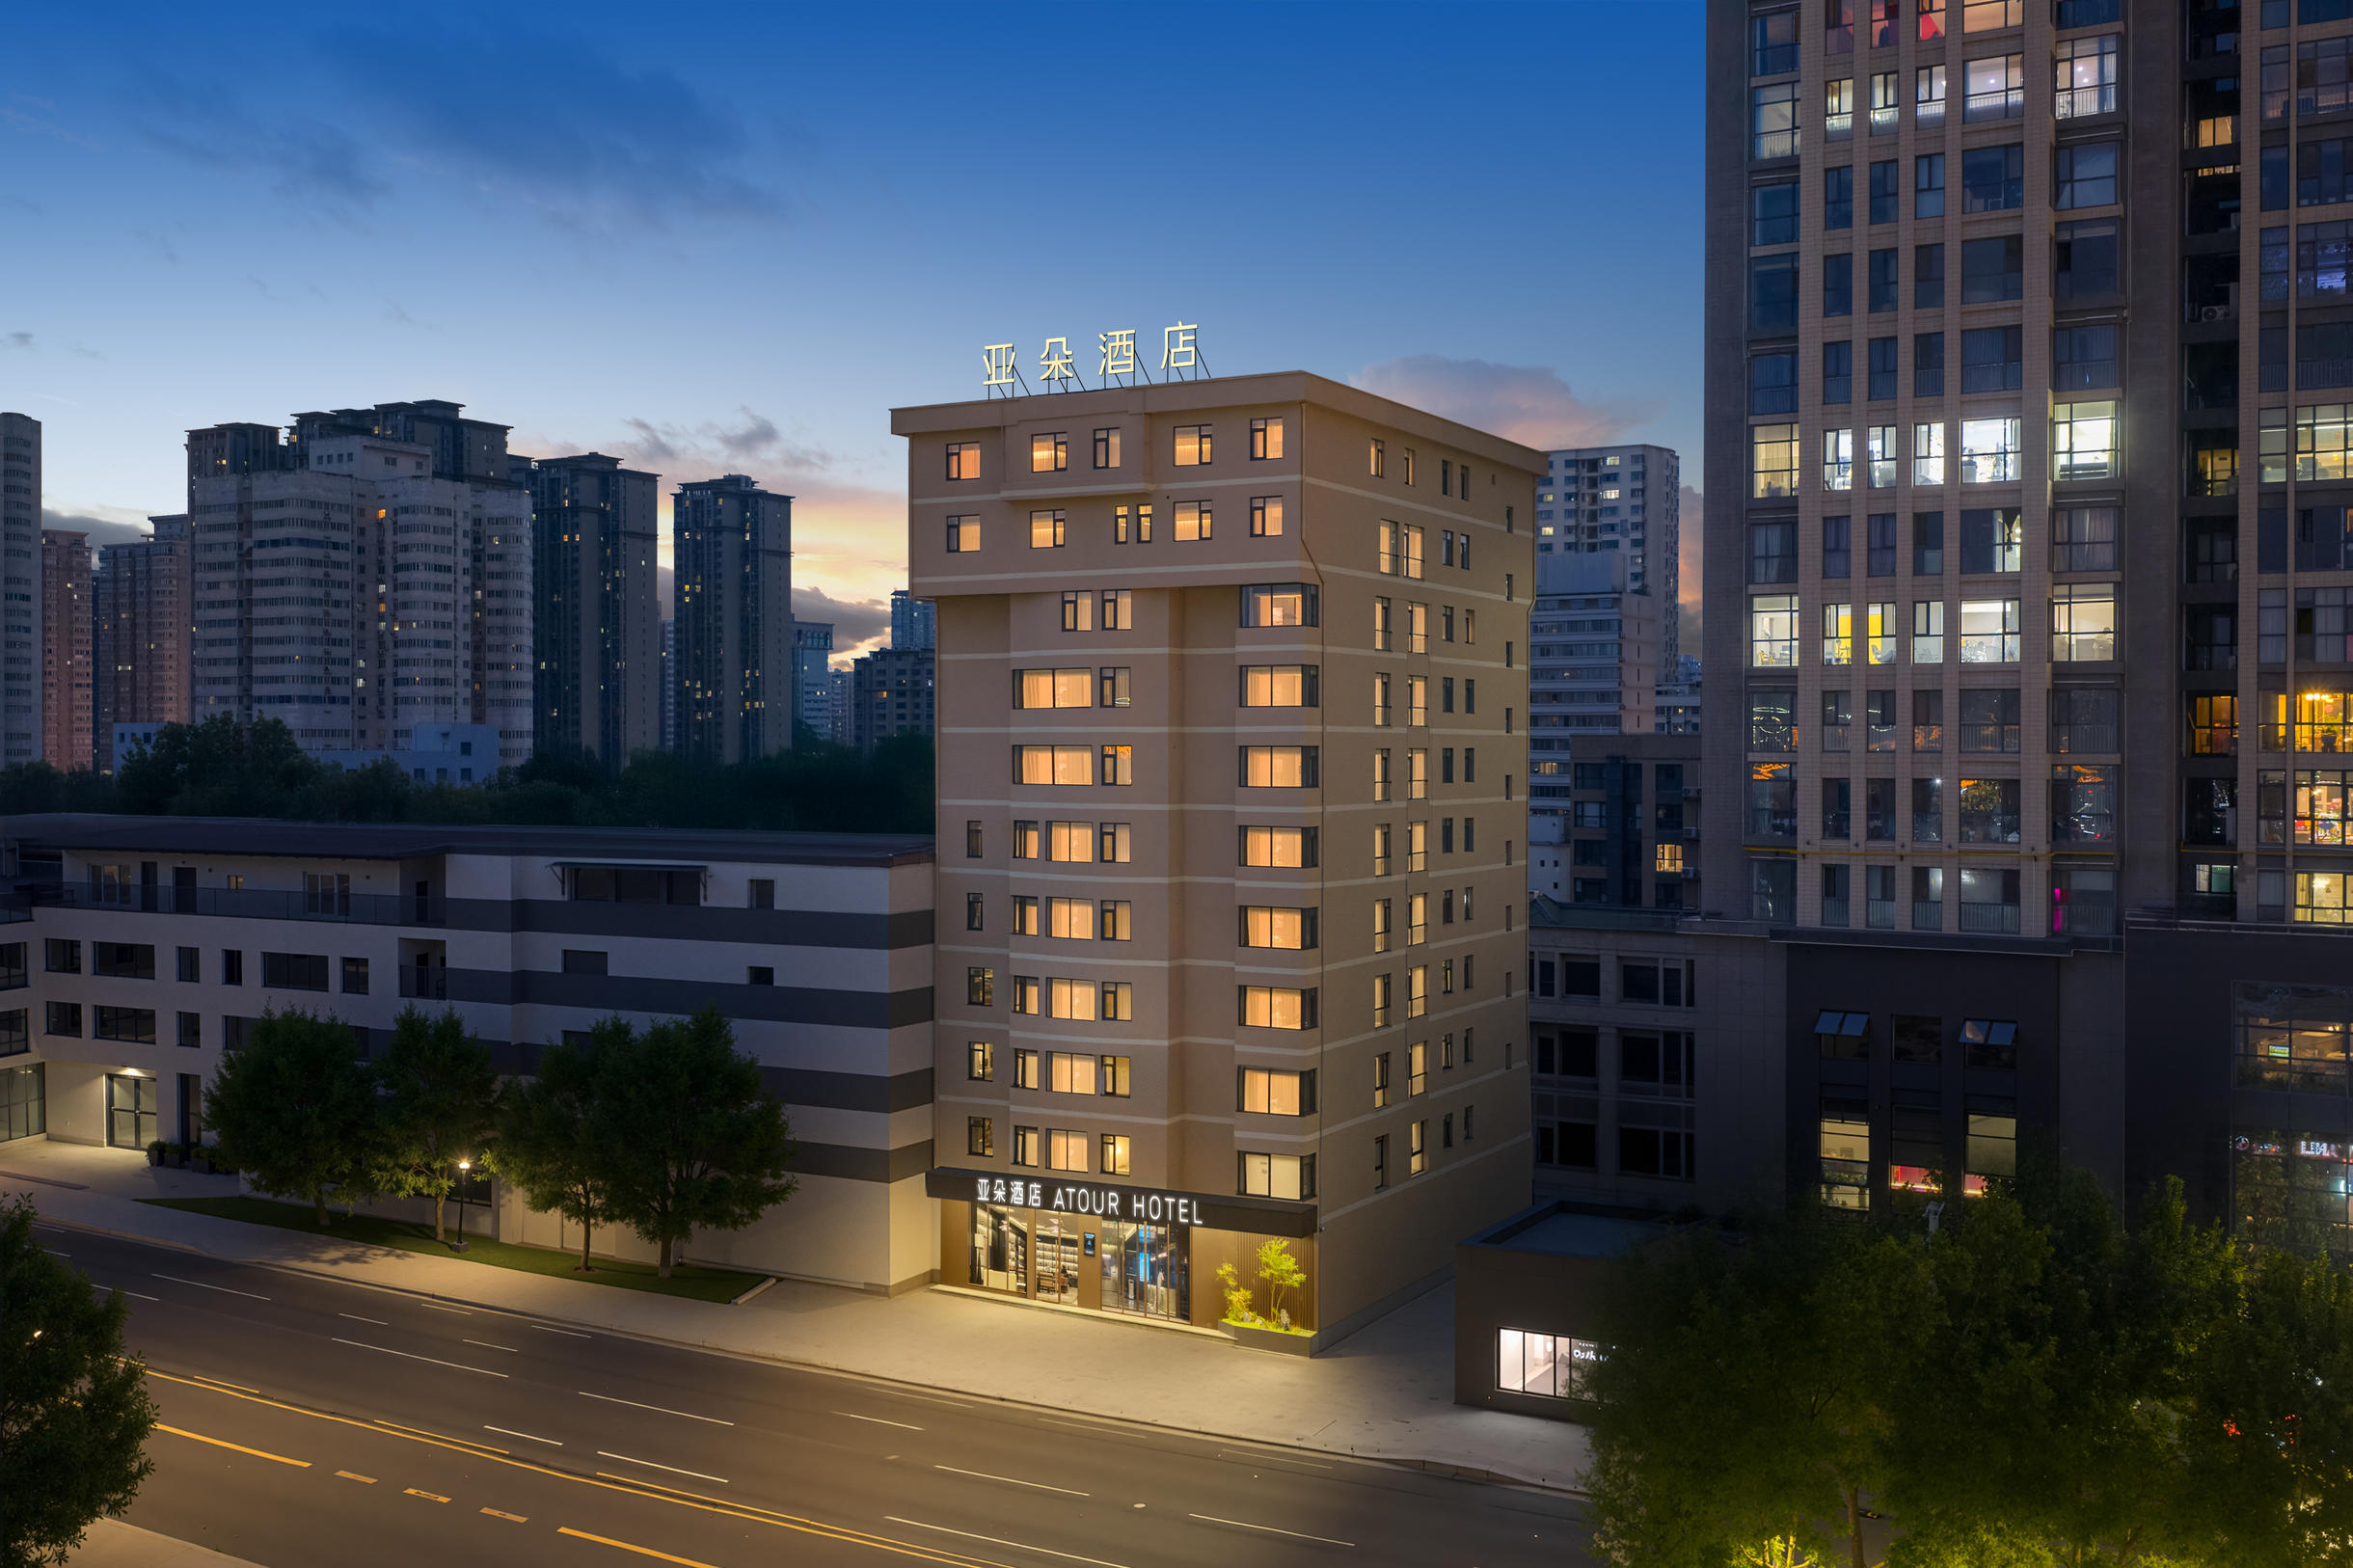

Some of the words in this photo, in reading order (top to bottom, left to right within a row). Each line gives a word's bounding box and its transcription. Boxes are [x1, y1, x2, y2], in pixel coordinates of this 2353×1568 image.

[983, 320, 1199, 386] 亚朵酒店
[977, 1178, 1041, 1207] 亚朵酒店
[1053, 1187, 1120, 1215] ATOUR
[1133, 1195, 1204, 1225] HOTEL
